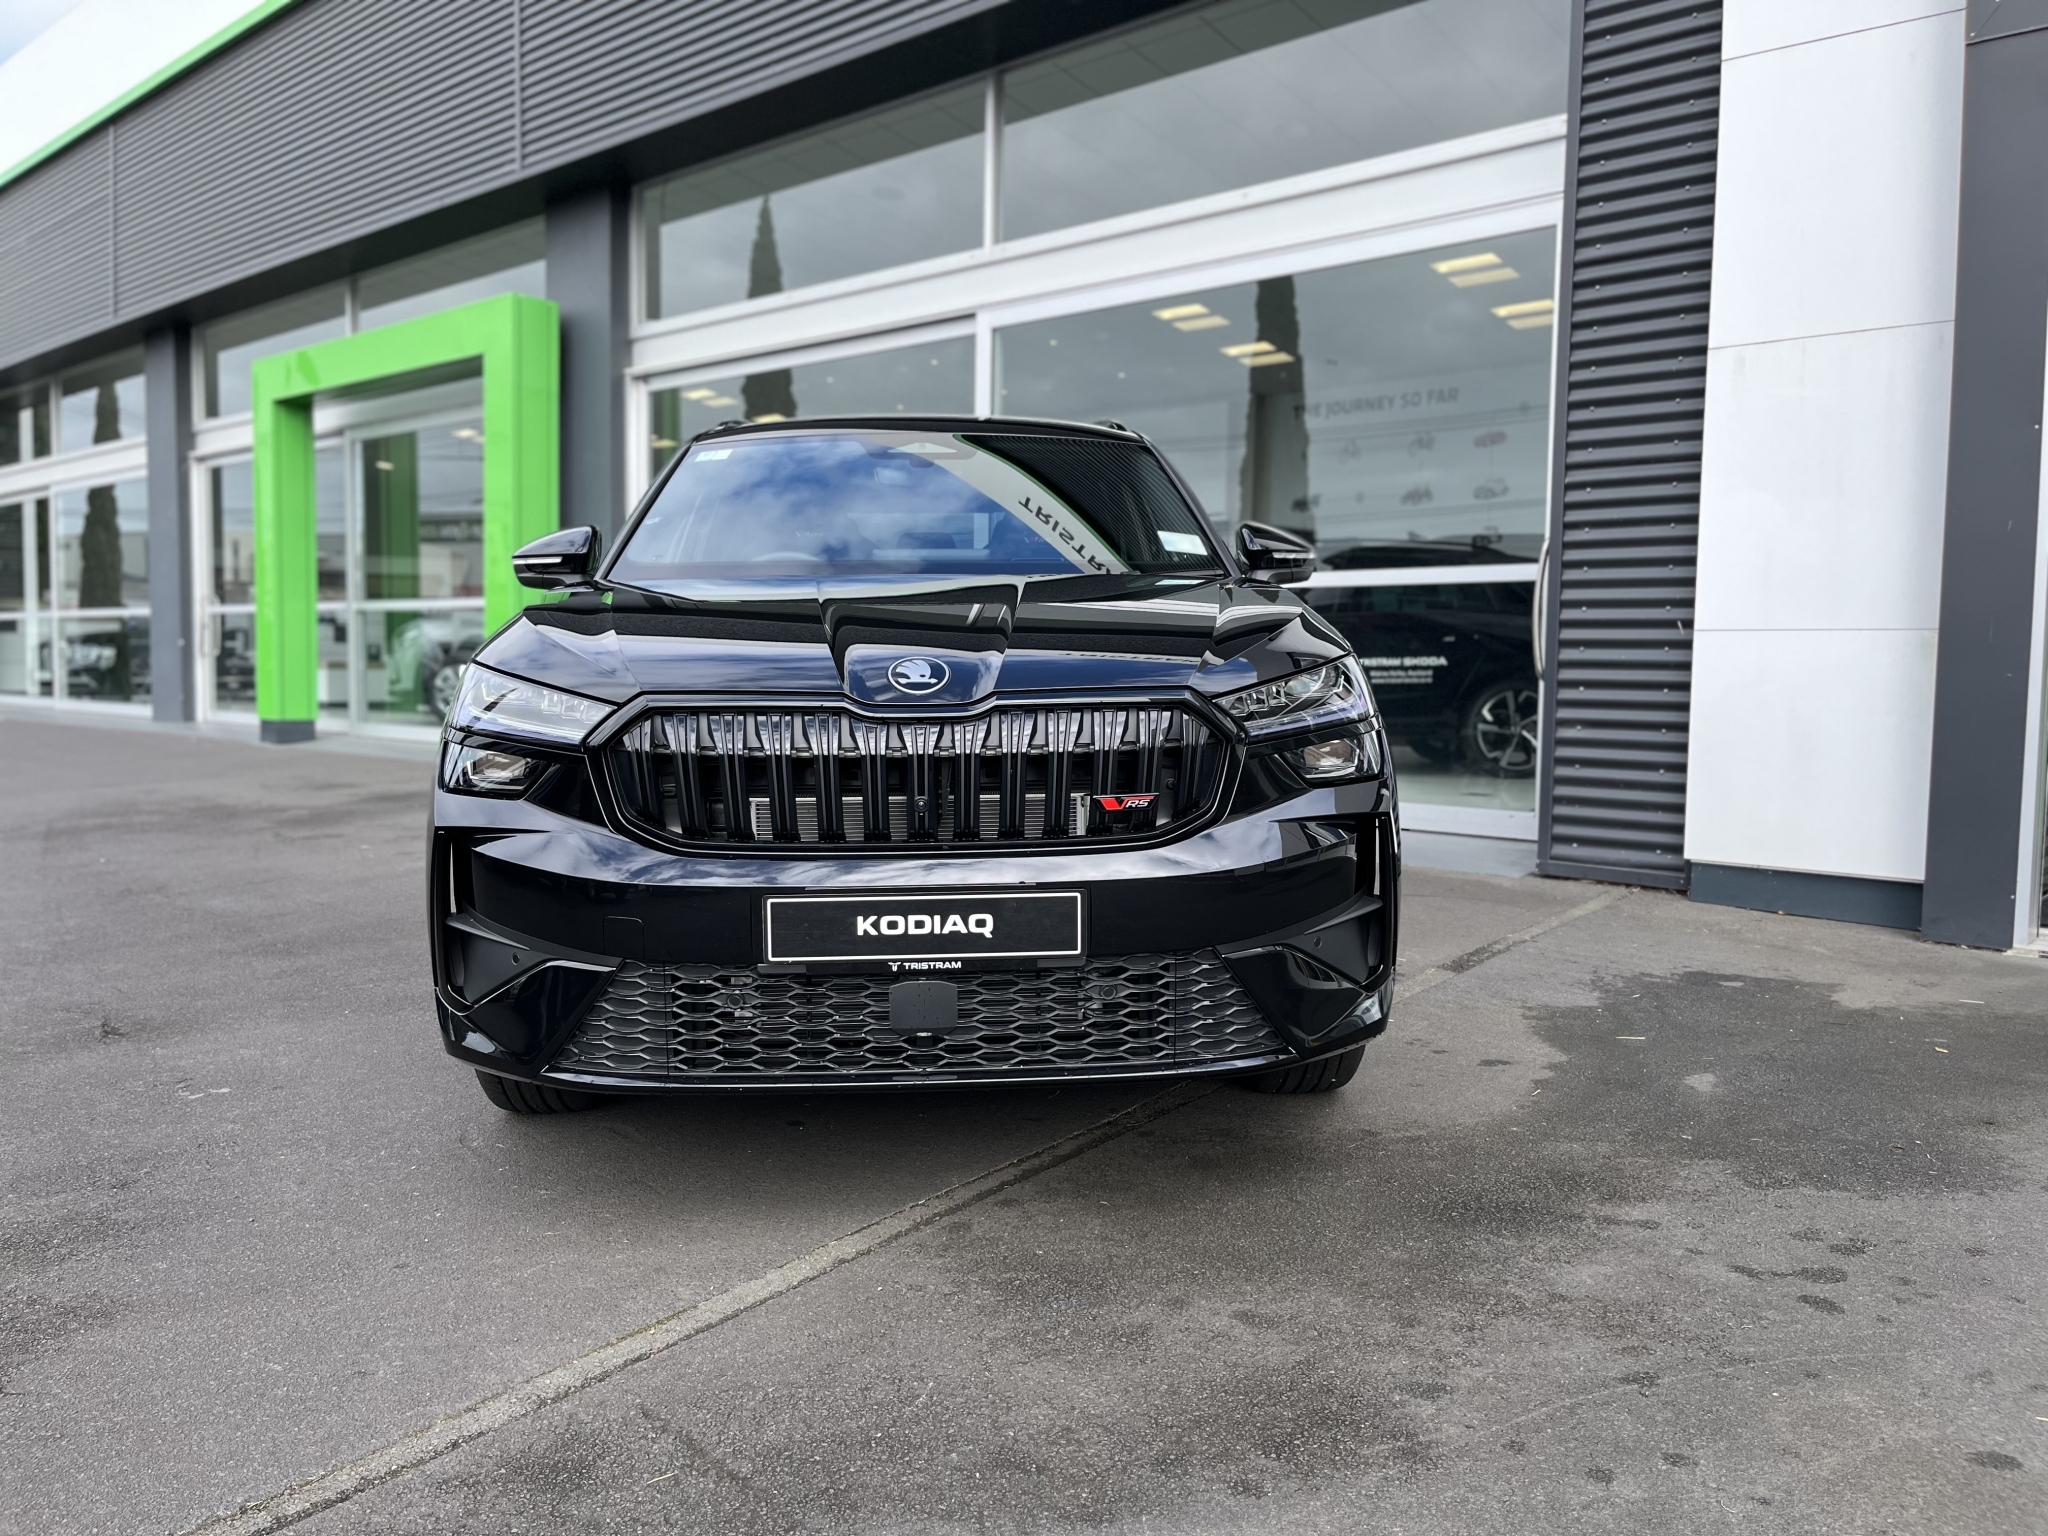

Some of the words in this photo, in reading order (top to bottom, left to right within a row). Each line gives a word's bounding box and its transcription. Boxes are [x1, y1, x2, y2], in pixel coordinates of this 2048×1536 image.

[1325, 394, 1396, 420] JOURNEY
[1400, 390, 1423, 410] SO
[1426, 386, 1459, 406] FAR
[856, 913, 994, 938] KODIAQ
[902, 960, 962, 970] TRISTRAM
